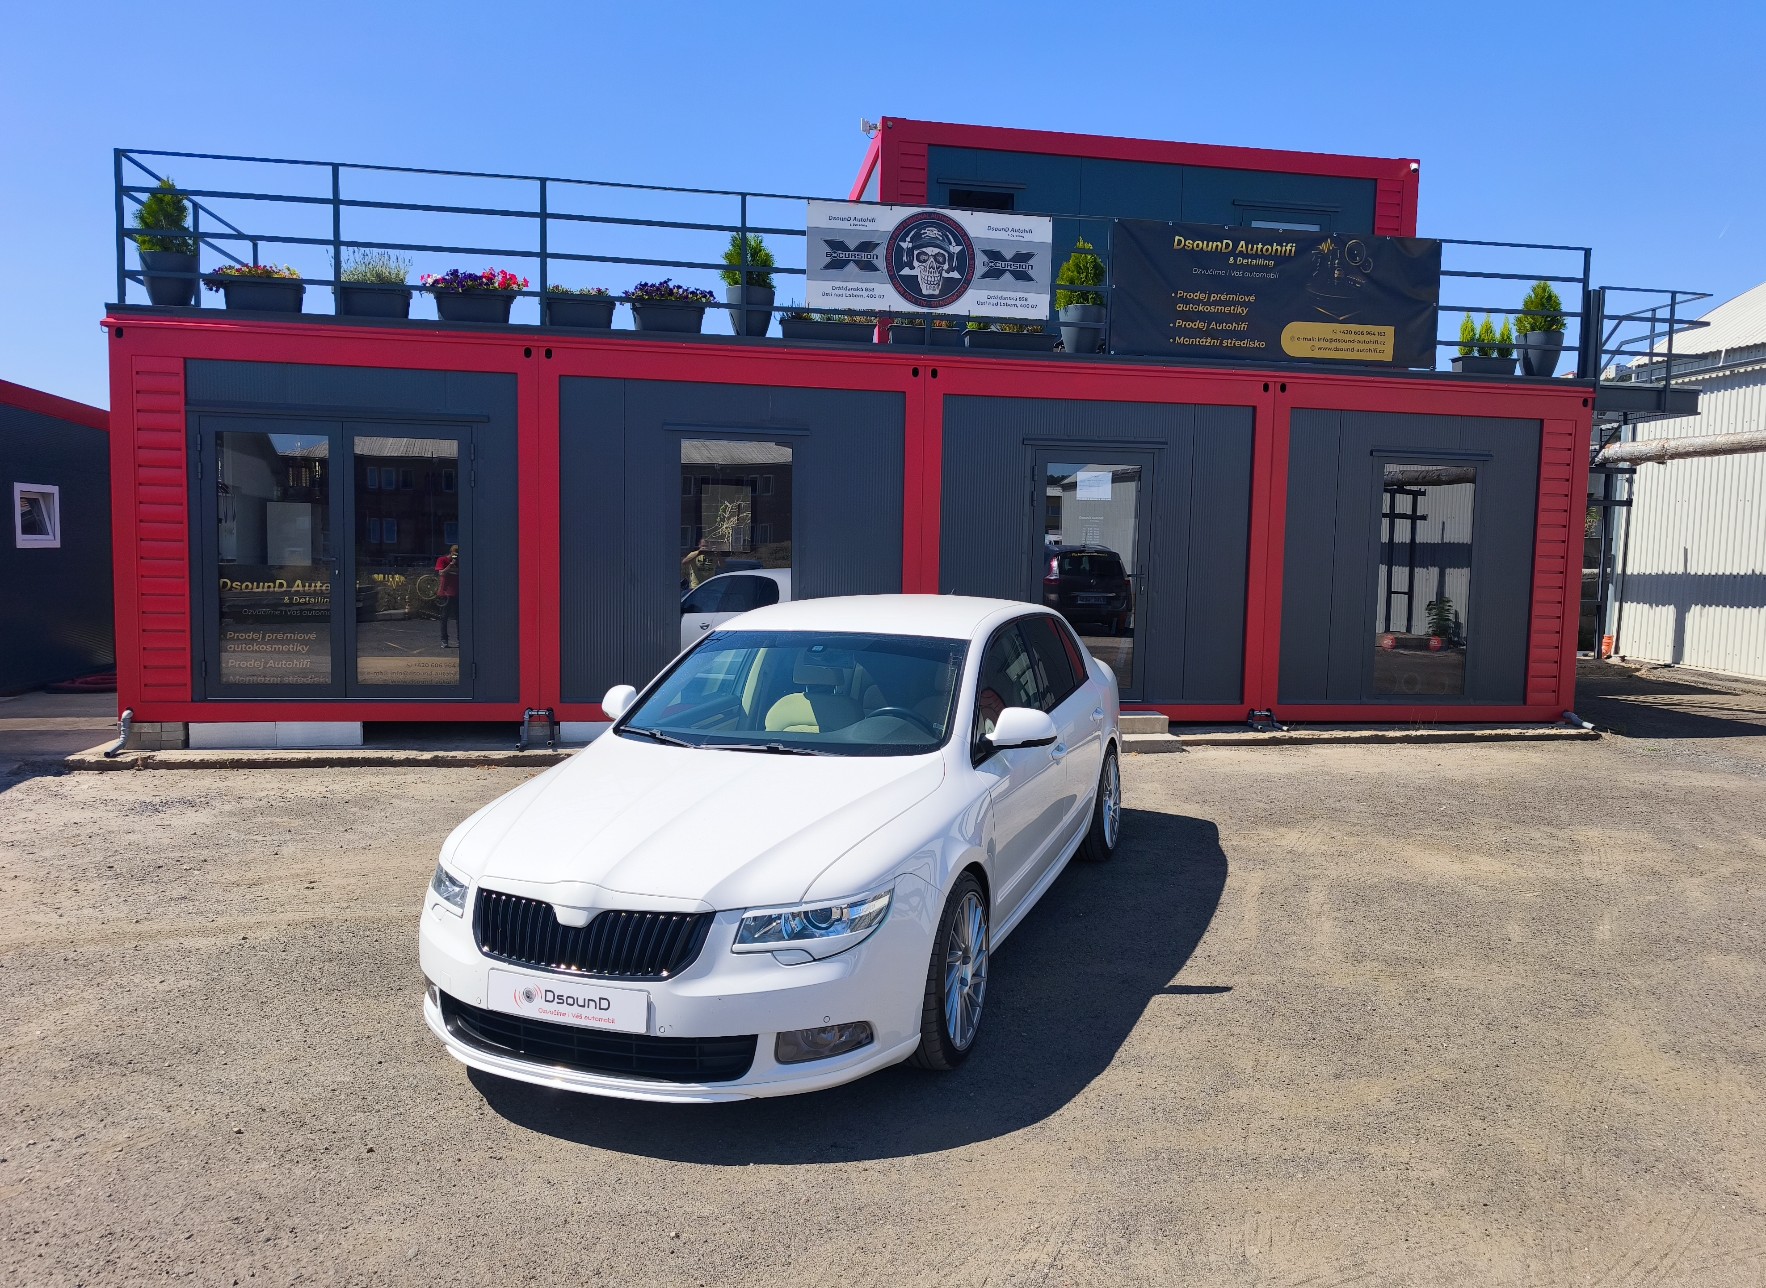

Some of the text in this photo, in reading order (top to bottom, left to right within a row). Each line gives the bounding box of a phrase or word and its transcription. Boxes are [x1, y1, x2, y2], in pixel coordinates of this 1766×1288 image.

[1173, 236, 1296, 257] DsounD Autohifi
[1237, 257, 1274, 267] Detailing
[1177, 290, 1256, 302] Prodej prémiové
[1176, 304, 1248, 315] autokosmetiky
[1175, 320, 1248, 331] Prodej Autohifi
[1175, 336, 1266, 348] Montážní středisko
[220, 579, 331, 593] DsounD Auto
[227, 631, 317, 641] Prodej prémiové
[227, 643, 310, 653] autokosmetiky
[228, 660, 311, 669] Prodej Autohifi
[545, 990, 611, 1011] DsounD
